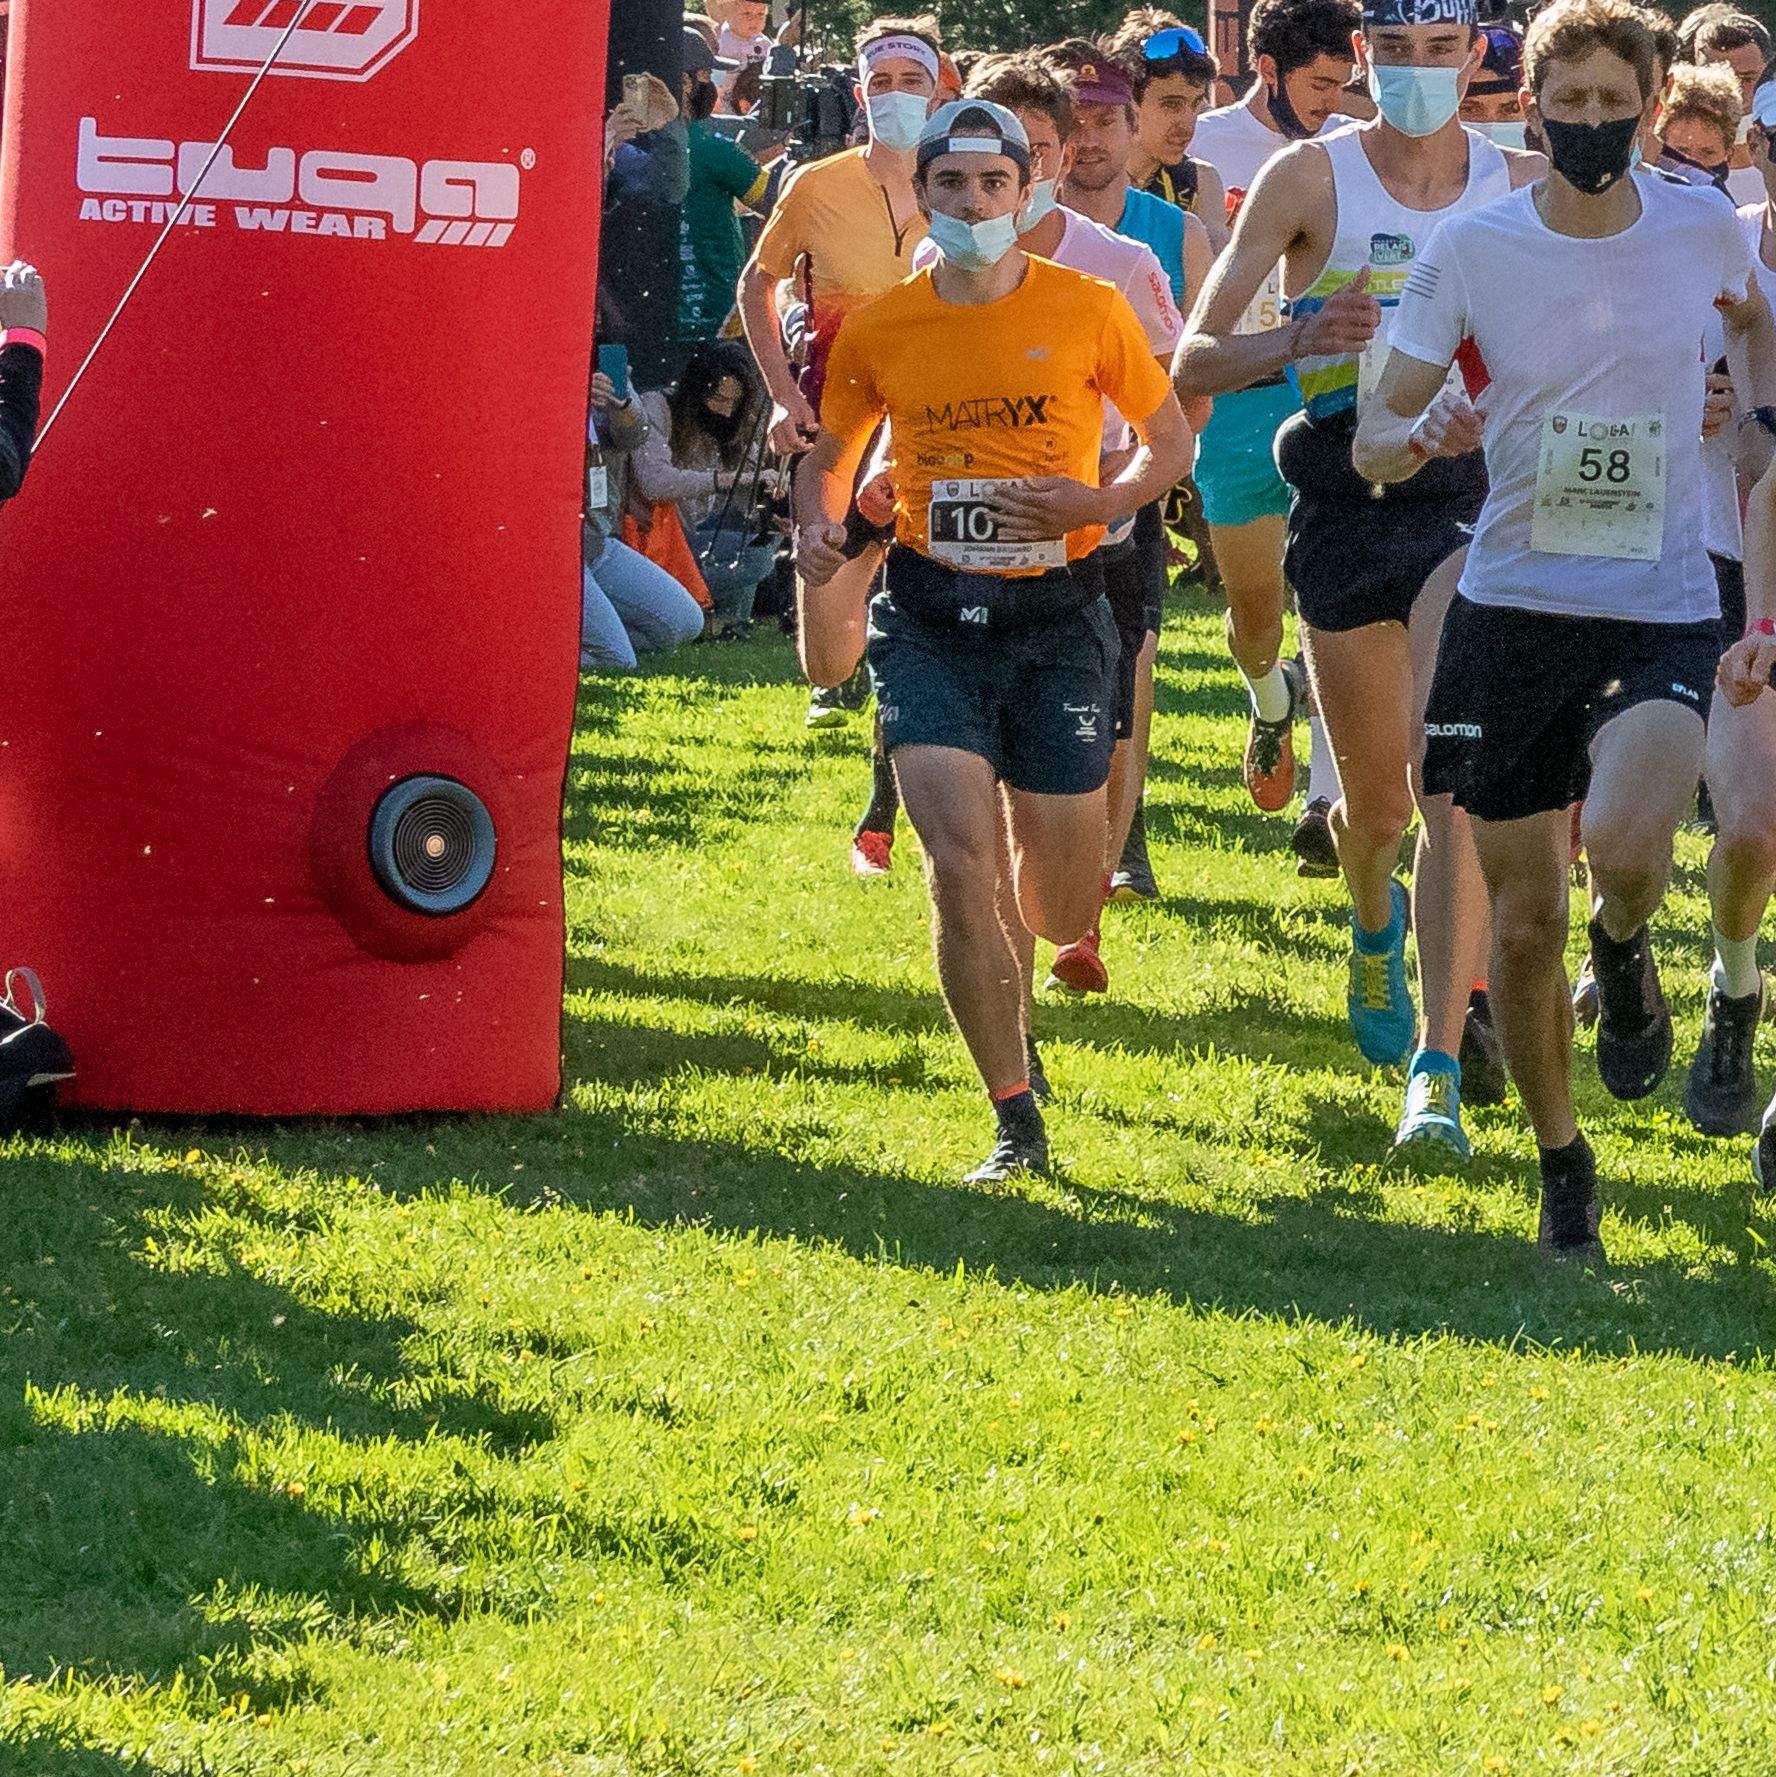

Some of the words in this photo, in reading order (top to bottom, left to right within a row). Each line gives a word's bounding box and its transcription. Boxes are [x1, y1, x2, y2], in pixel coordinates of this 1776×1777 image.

[79, 199, 217, 227] ACTIVE
[234, 206, 388, 241] WEAR
[1578, 447, 1631, 483] 58
